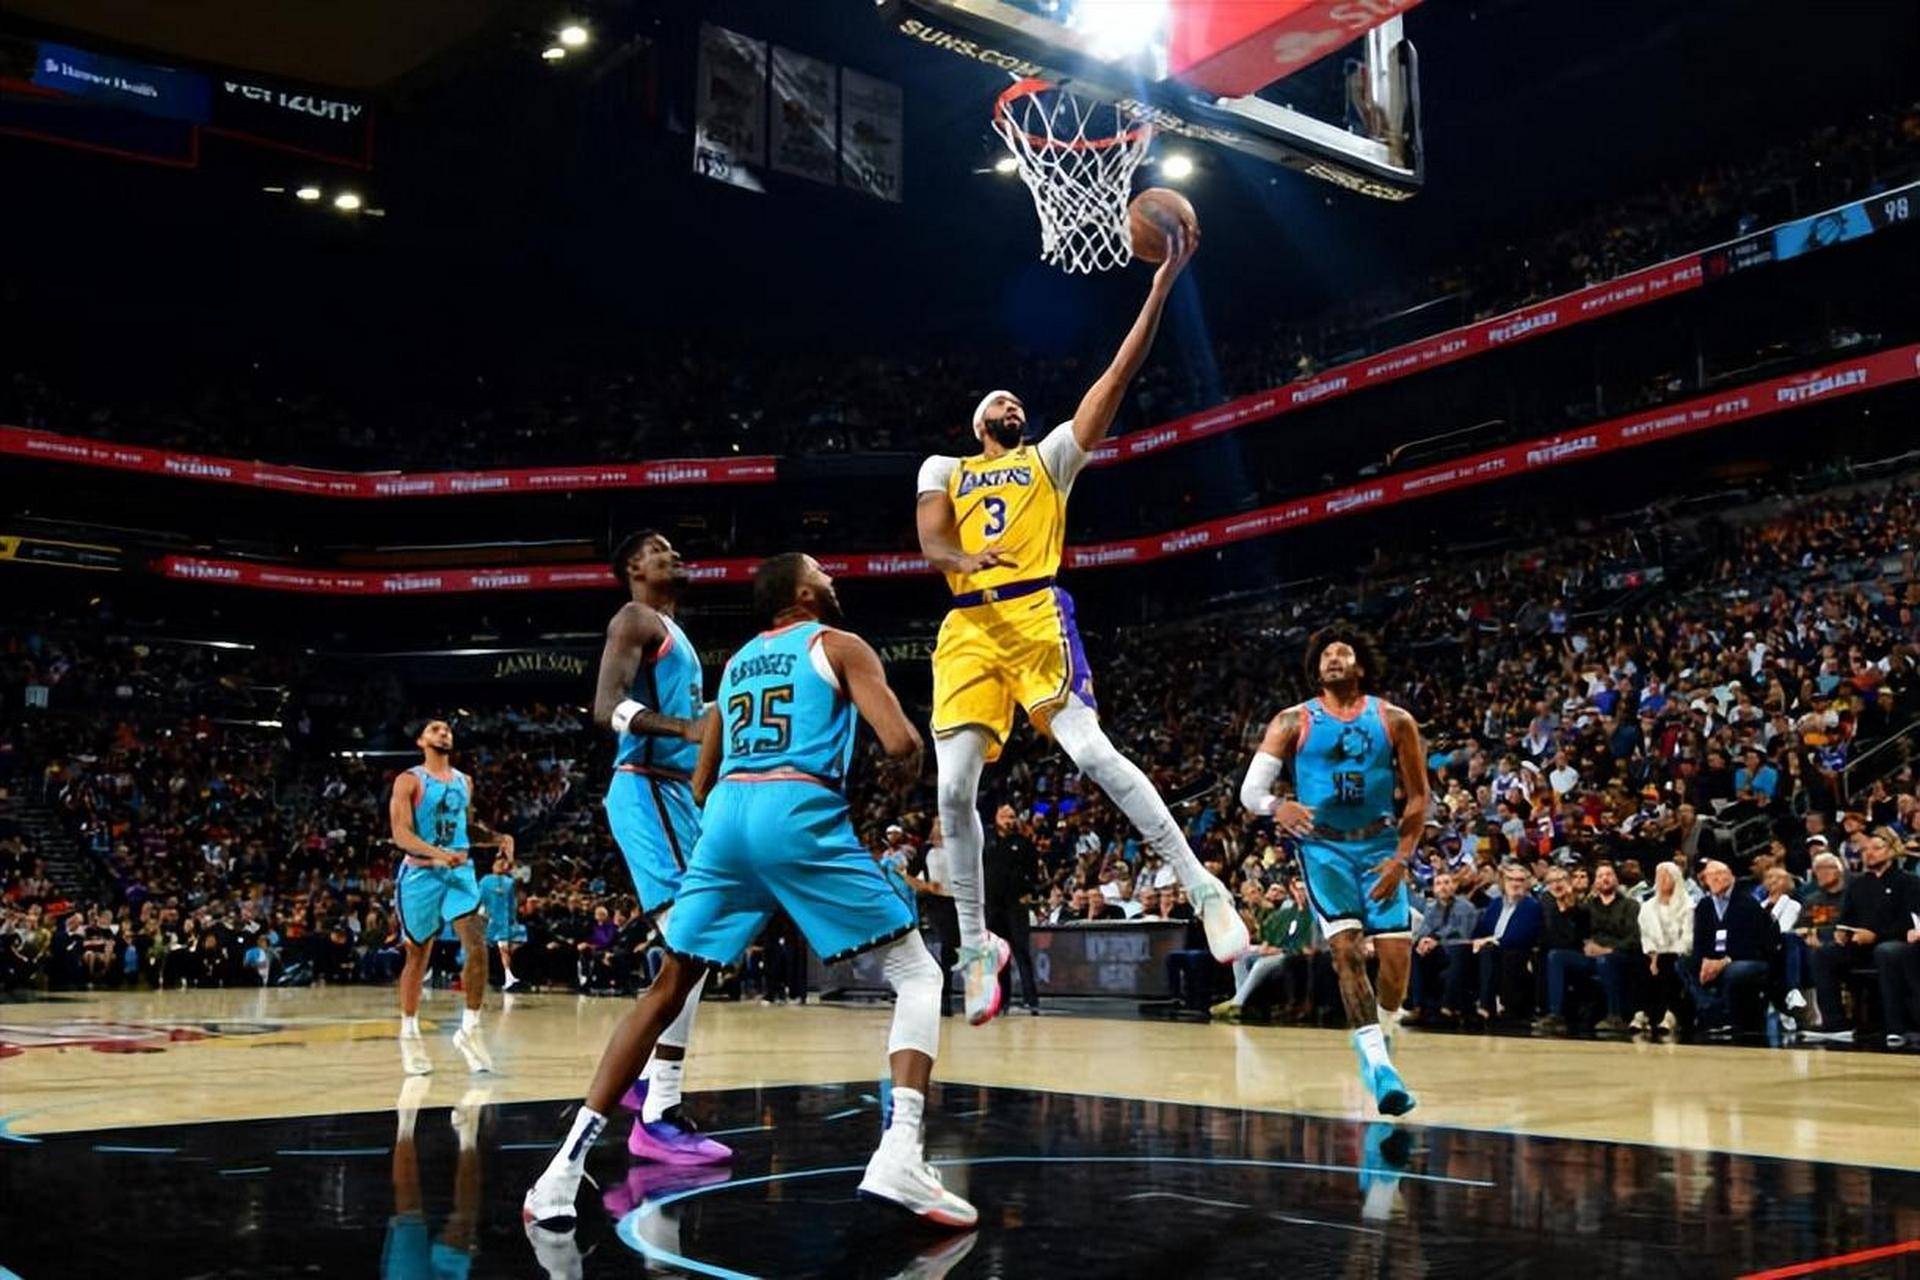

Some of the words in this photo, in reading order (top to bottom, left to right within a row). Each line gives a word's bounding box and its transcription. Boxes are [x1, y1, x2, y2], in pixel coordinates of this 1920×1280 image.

[900, 18, 1043, 76] SUNS.COM
[957, 467, 1031, 498] LAKERS
[984, 496, 1006, 537] 3
[728, 684, 794, 756] 25
